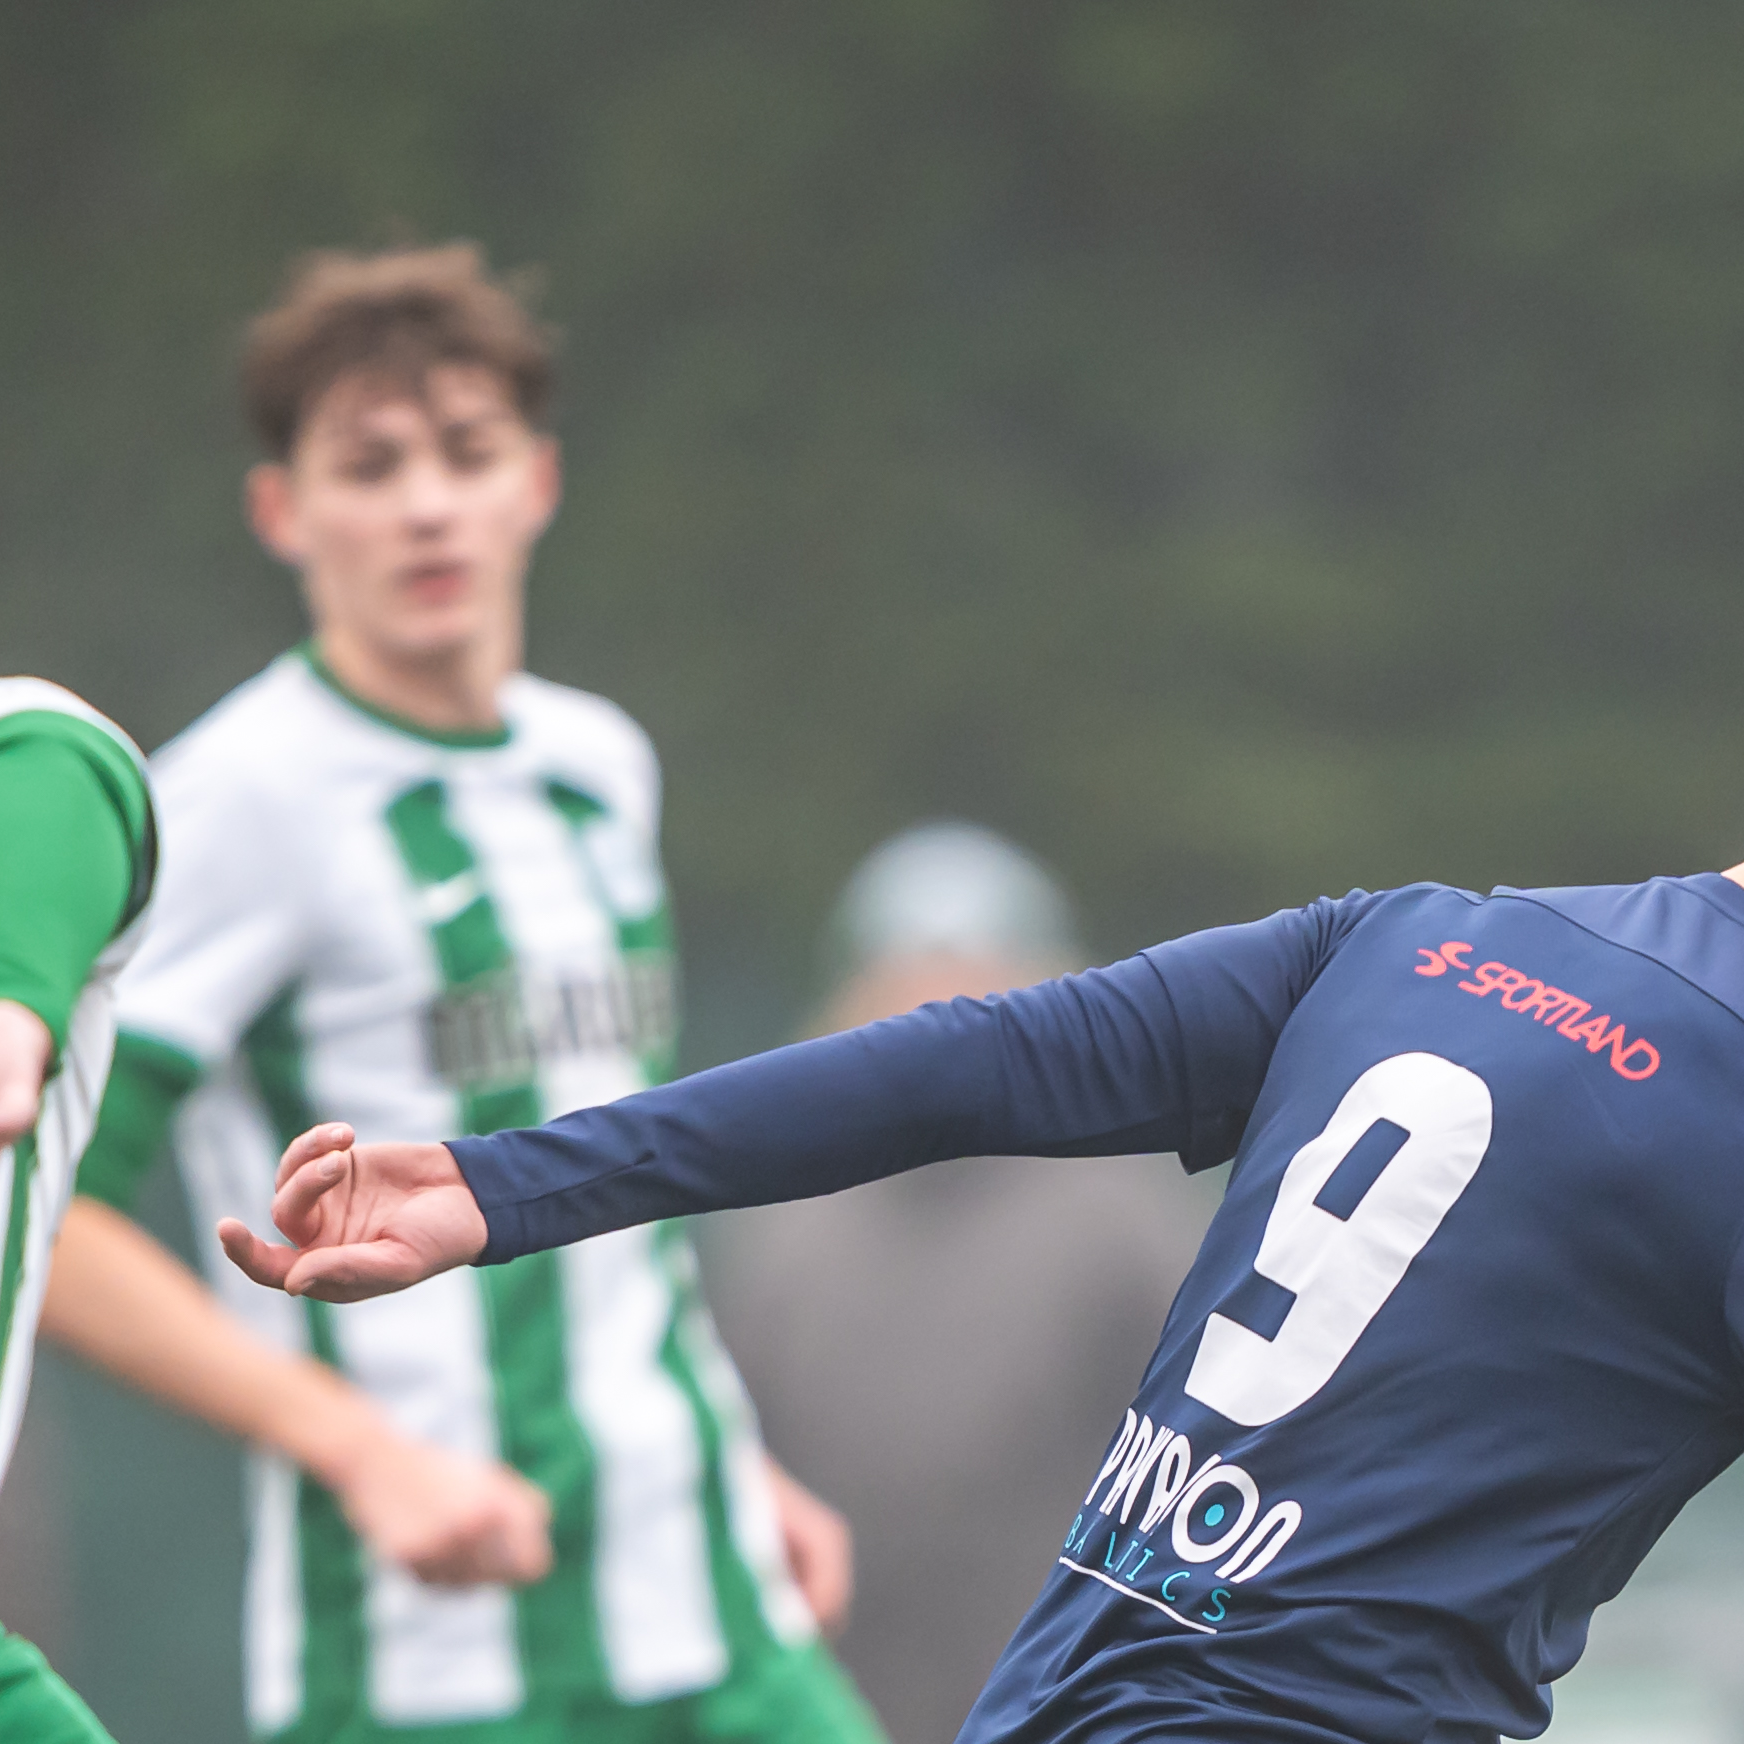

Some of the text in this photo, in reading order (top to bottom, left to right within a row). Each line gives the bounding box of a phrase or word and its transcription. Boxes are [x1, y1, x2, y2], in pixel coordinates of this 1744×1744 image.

[1457, 961, 1661, 1081] SPORTLAND
[1183, 1051, 1493, 1426] 9
[1064, 1513, 1232, 1622] BALTICS
